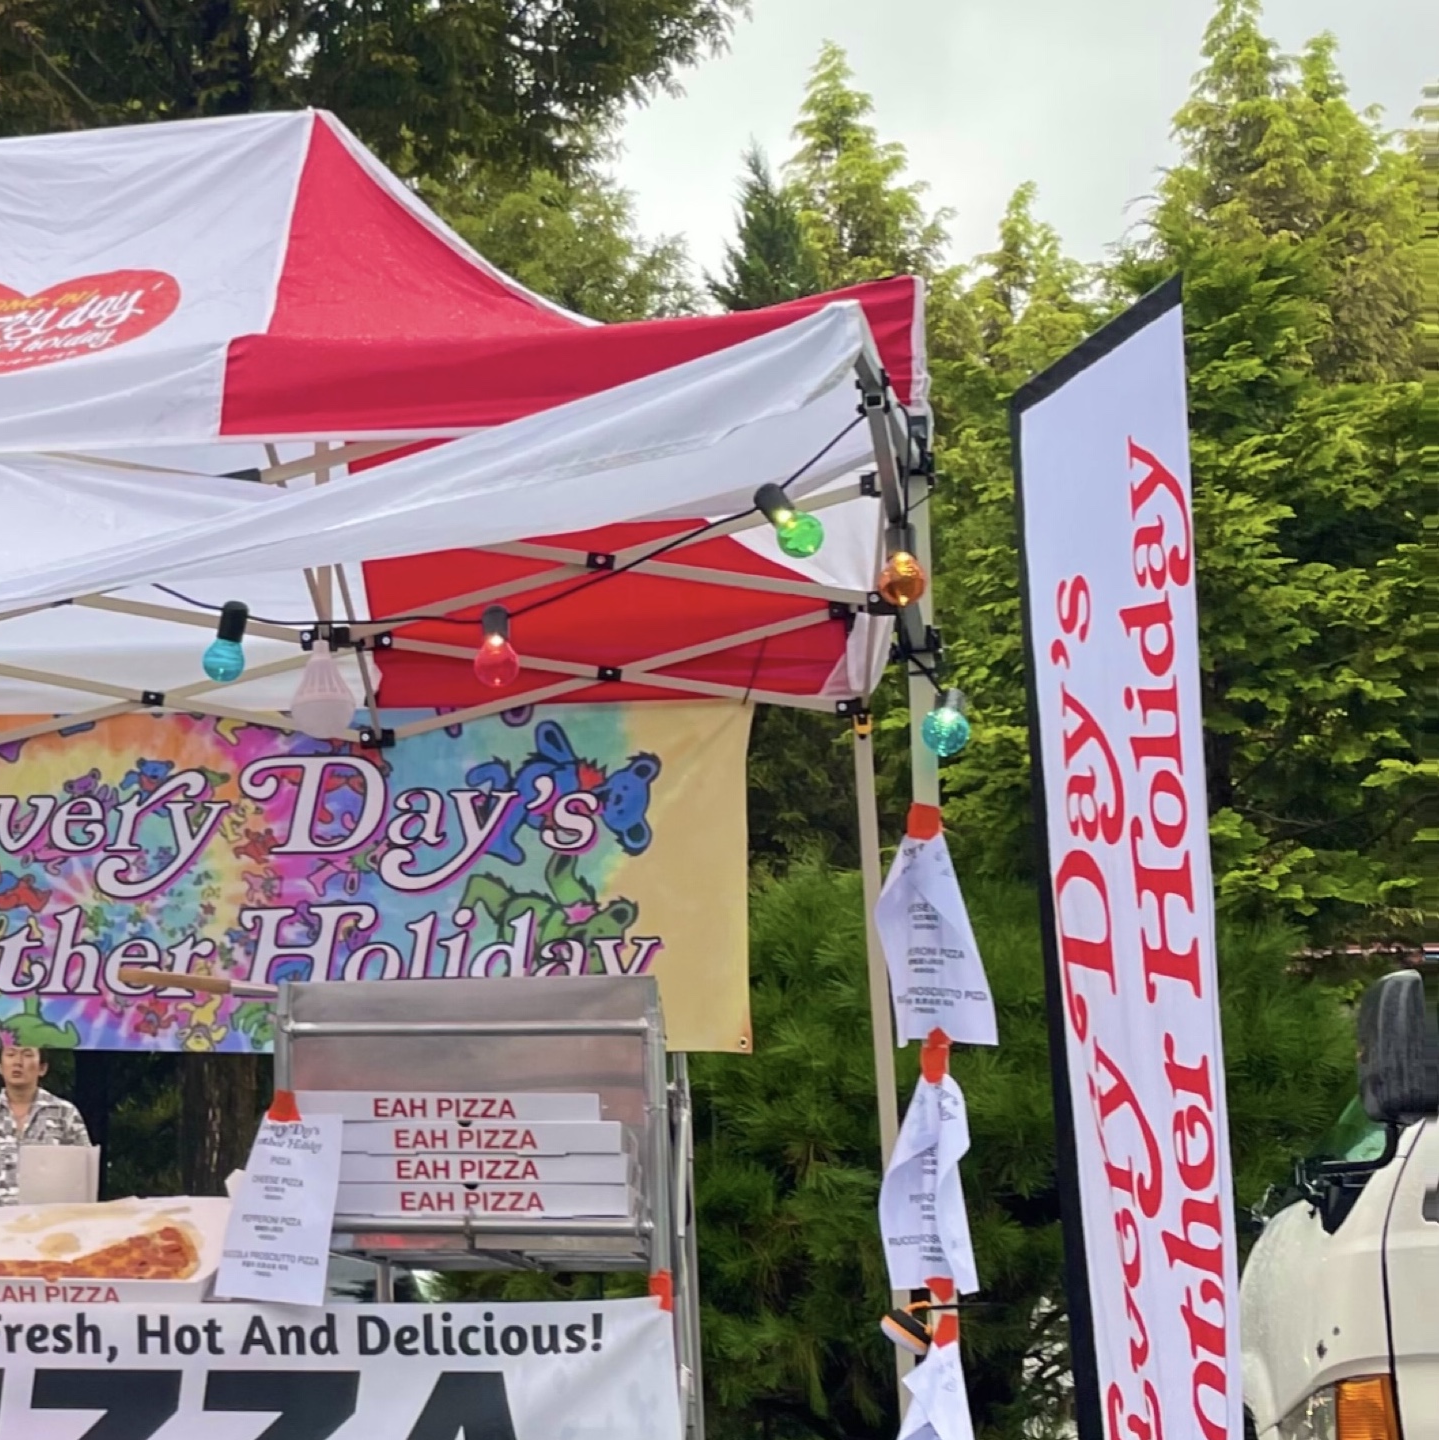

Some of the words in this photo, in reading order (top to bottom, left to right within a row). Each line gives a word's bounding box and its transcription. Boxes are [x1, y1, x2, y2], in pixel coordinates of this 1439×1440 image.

[1118, 434, 1203, 1004] Holiday
[1049, 574, 1125, 1046] Day's
[239, 755, 603, 893] Day's
[373, 1097, 427, 1119] EAH
[437, 1098, 516, 1120] PIZZA
[394, 1129, 448, 1149] EAH
[459, 1130, 538, 1151] PIZZA
[396, 1159, 450, 1180] EAH
[460, 1160, 540, 1181] PIZZA
[400, 1191, 455, 1212] EAH
[464, 1191, 545, 1213] PIZZA
[44, 1286, 120, 1303] PIZZA
[137, 1315, 224, 1356] Hot
[240, 1314, 339, 1356] And
[357, 1312, 604, 1357] Delicious!
